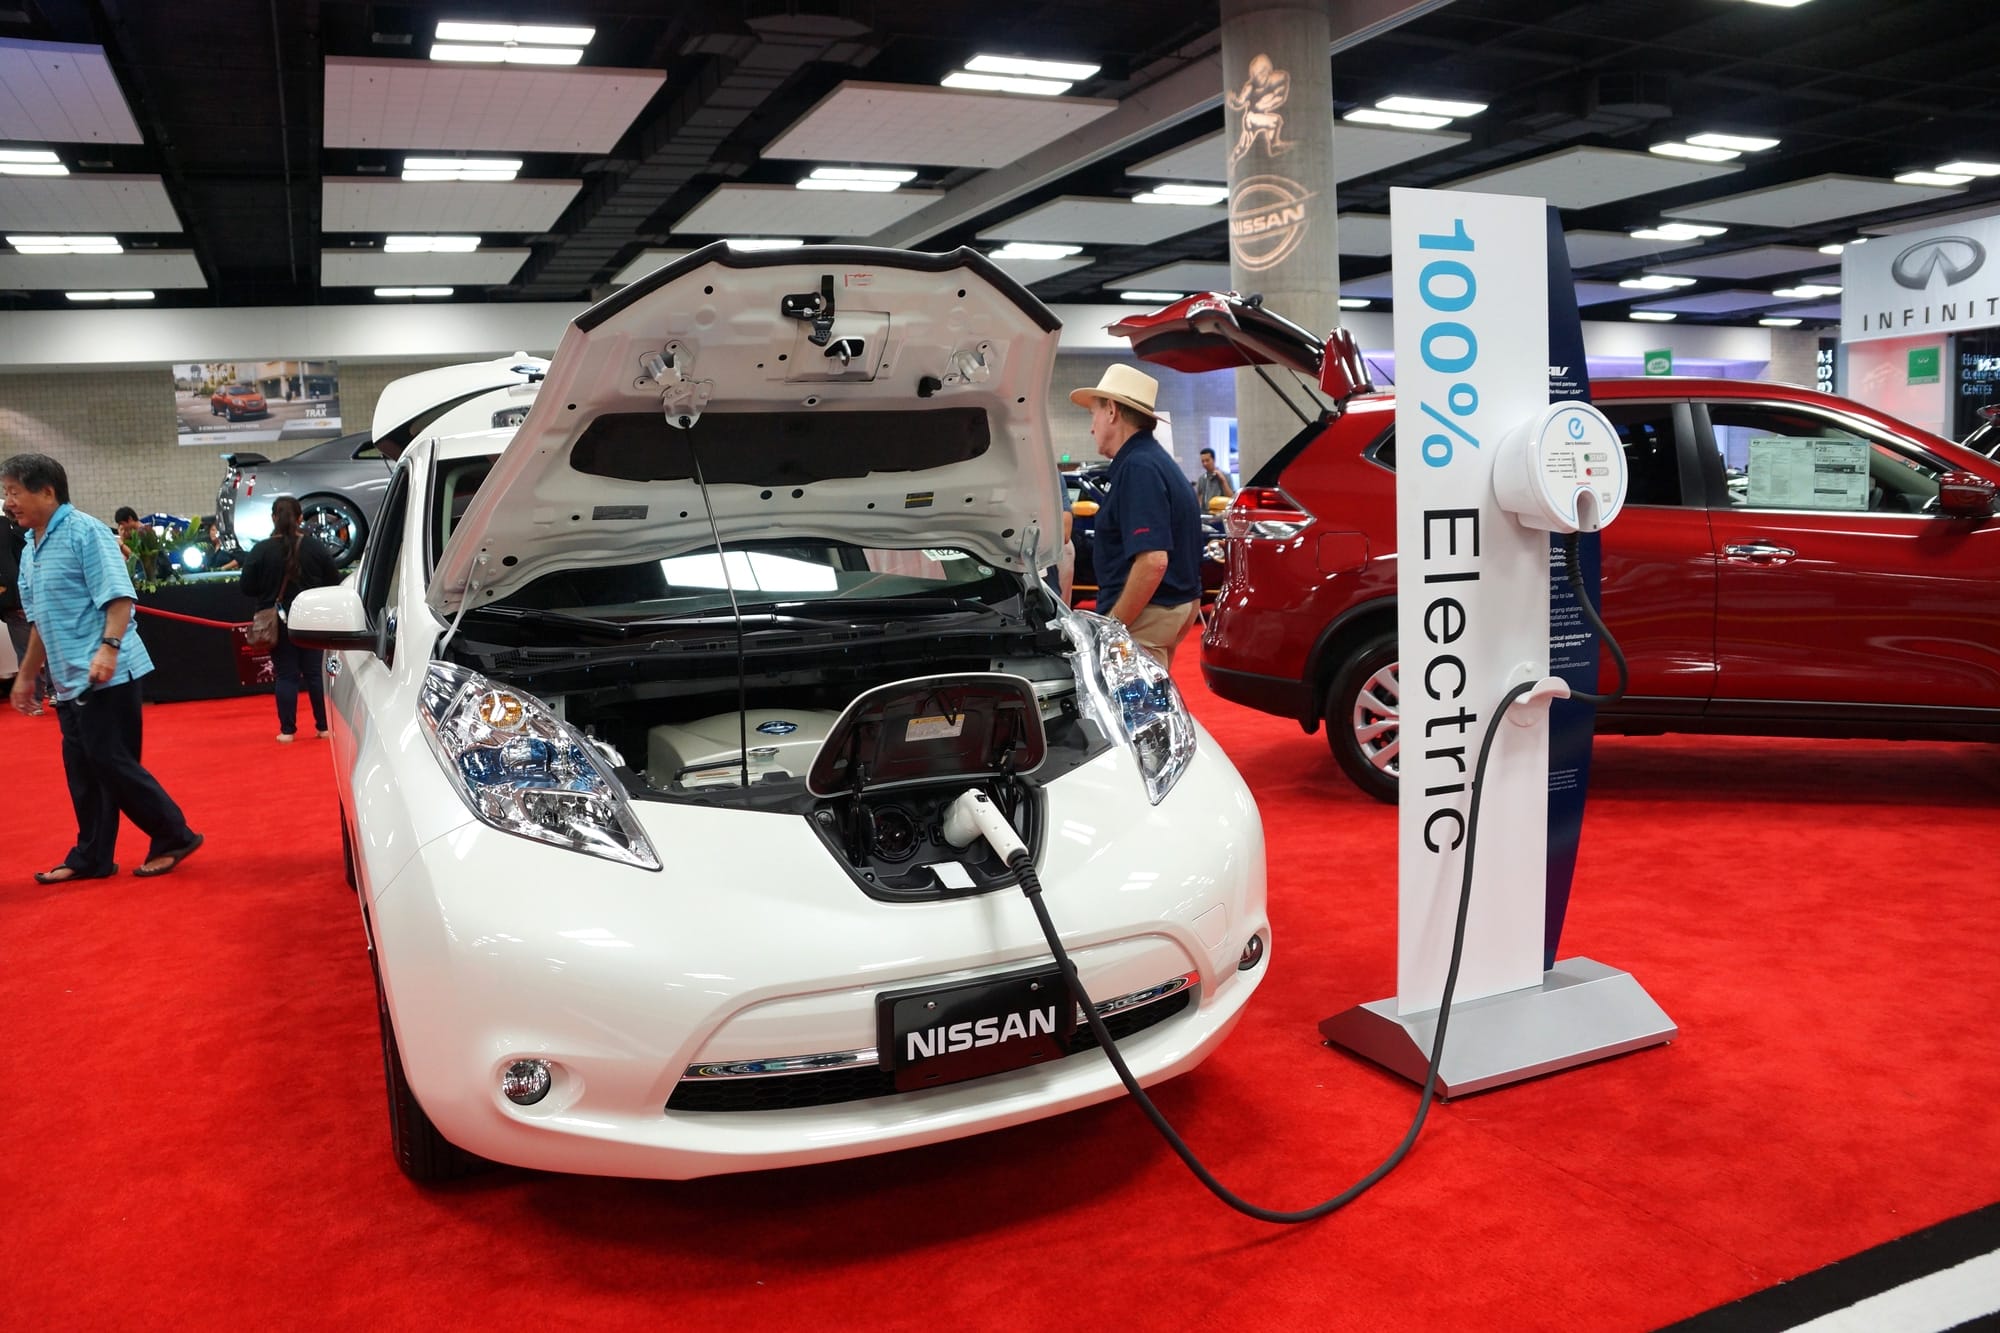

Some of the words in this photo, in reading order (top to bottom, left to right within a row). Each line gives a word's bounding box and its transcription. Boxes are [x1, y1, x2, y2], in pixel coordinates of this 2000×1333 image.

[1863, 297, 2000, 332] INFINIT
[1418, 218, 1480, 467] 100%
[305, 409, 327, 417] TRAX
[1423, 508, 1480, 853] Electric
[907, 1006, 1055, 1061] NISSAN
